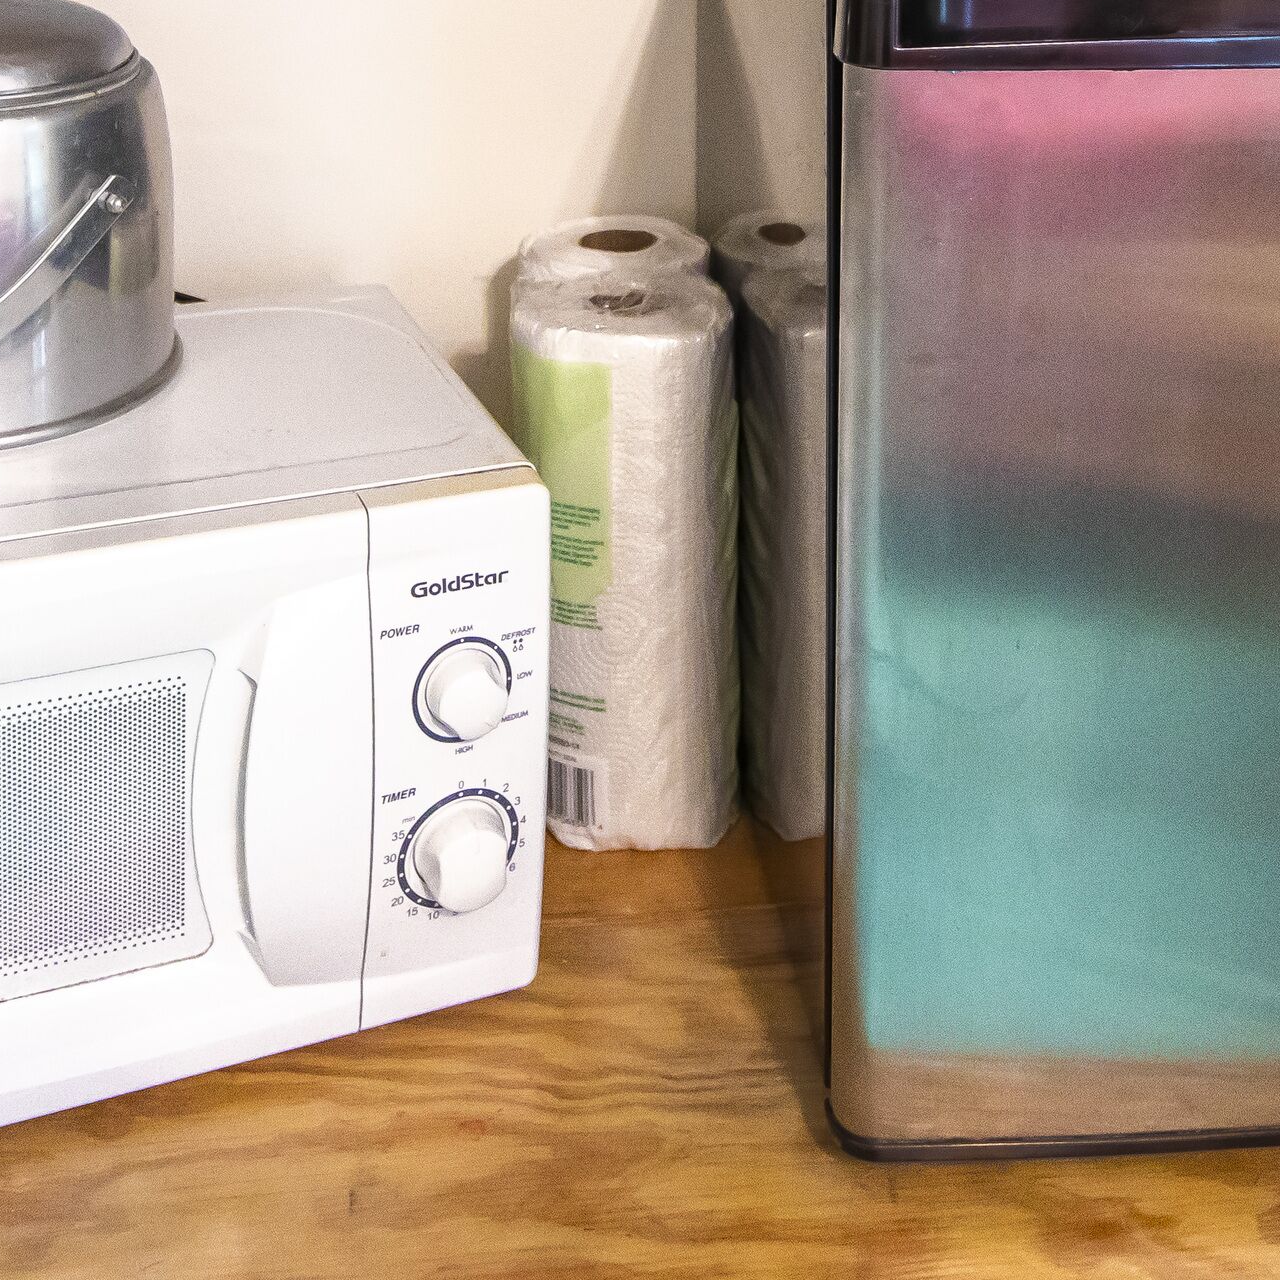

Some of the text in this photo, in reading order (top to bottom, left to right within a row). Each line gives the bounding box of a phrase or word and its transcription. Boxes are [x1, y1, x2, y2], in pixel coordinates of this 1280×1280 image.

[410, 571, 509, 598] GoldStar
[380, 624, 420, 640] POWER
[449, 625, 474, 635] WARM
[501, 626, 536, 641] DEFROST
[516, 670, 533, 680] LOW
[501, 710, 529, 722] MEDIUM
[455, 745, 474, 756] HIGH
[458, 780, 465, 790] 0
[482, 778, 487, 787] 1
[502, 783, 510, 793] 2
[381, 787, 416, 804] TIMER
[514, 796, 521, 806] 3
[520, 815, 527, 824] 4
[391, 830, 405, 842] 35
[518, 838, 526, 847] 5
[383, 853, 397, 865] 30
[508, 862, 516, 872] 6
[382, 876, 396, 888] 25
[391, 896, 404, 907] 20
[407, 907, 418, 917] 15
[427, 910, 440, 920] 10
